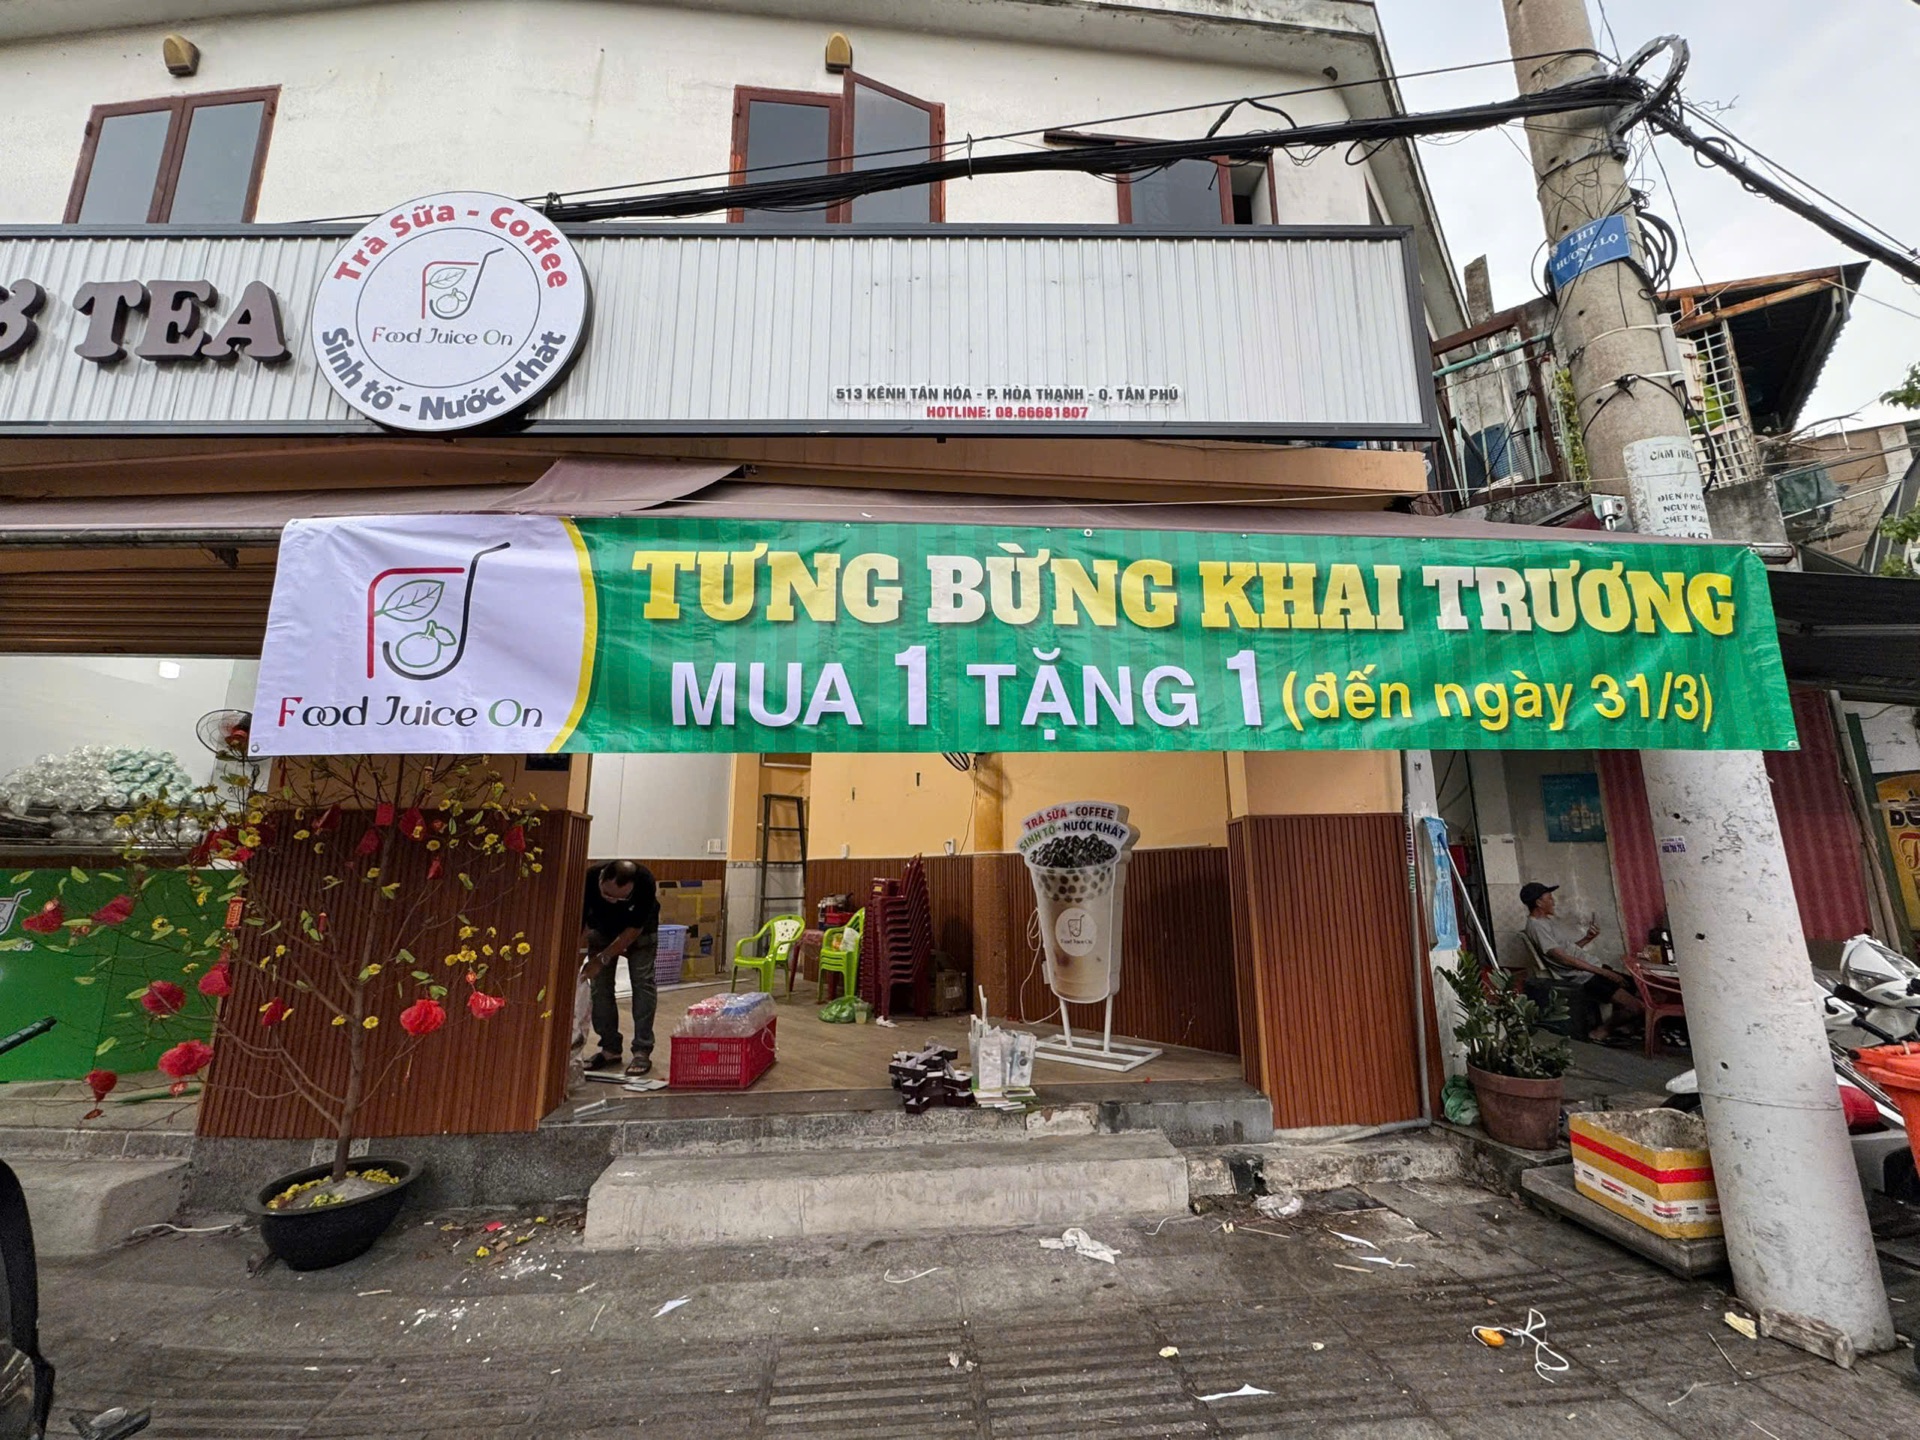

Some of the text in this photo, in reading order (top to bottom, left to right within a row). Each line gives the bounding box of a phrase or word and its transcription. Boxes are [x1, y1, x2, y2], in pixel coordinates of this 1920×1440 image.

[334, 235, 388, 281] Trà
[390, 204, 455, 238] Sữa
[490, 206, 568, 289] Coffee
[1569, 225, 1597, 247] LHT
[73, 280, 290, 363] TEA
[372, 326, 512, 346] Food Juice On
[322, 327, 365, 389] Sinh
[360, 379, 404, 411] tố
[418, 385, 506, 421] Nước
[501, 330, 567, 394] khát
[836, 388, 862, 400] 513
[867, 385, 906, 400] KÊNH
[910, 385, 938, 400] TÂN
[943, 386, 972, 400] HÓA
[987, 388, 998, 400] P.
[1003, 385, 1031, 400] HÒA
[1036, 388, 1084, 402] THẠNH
[1117, 385, 1145, 400] TÂN
[1150, 385, 1179, 400] PHÚ
[927, 406, 1089, 419] HOTLINE: 08.66681807
[631, 541, 1736, 636] TƯNG BỪNG KHAI TRƯƠNG
[672, 645, 1714, 741] MUA 1 TẶNG 1 (đến ngày 31/3)
[278, 695, 543, 728] Food Juice On
[1025, 813, 1046, 830] TRÀ
[1075, 806, 1115, 820] COFFEE
[1020, 831, 1042, 852] SINH
[1063, 818, 1094, 832] NƯỚC
[1095, 821, 1127, 839] KHÁT
